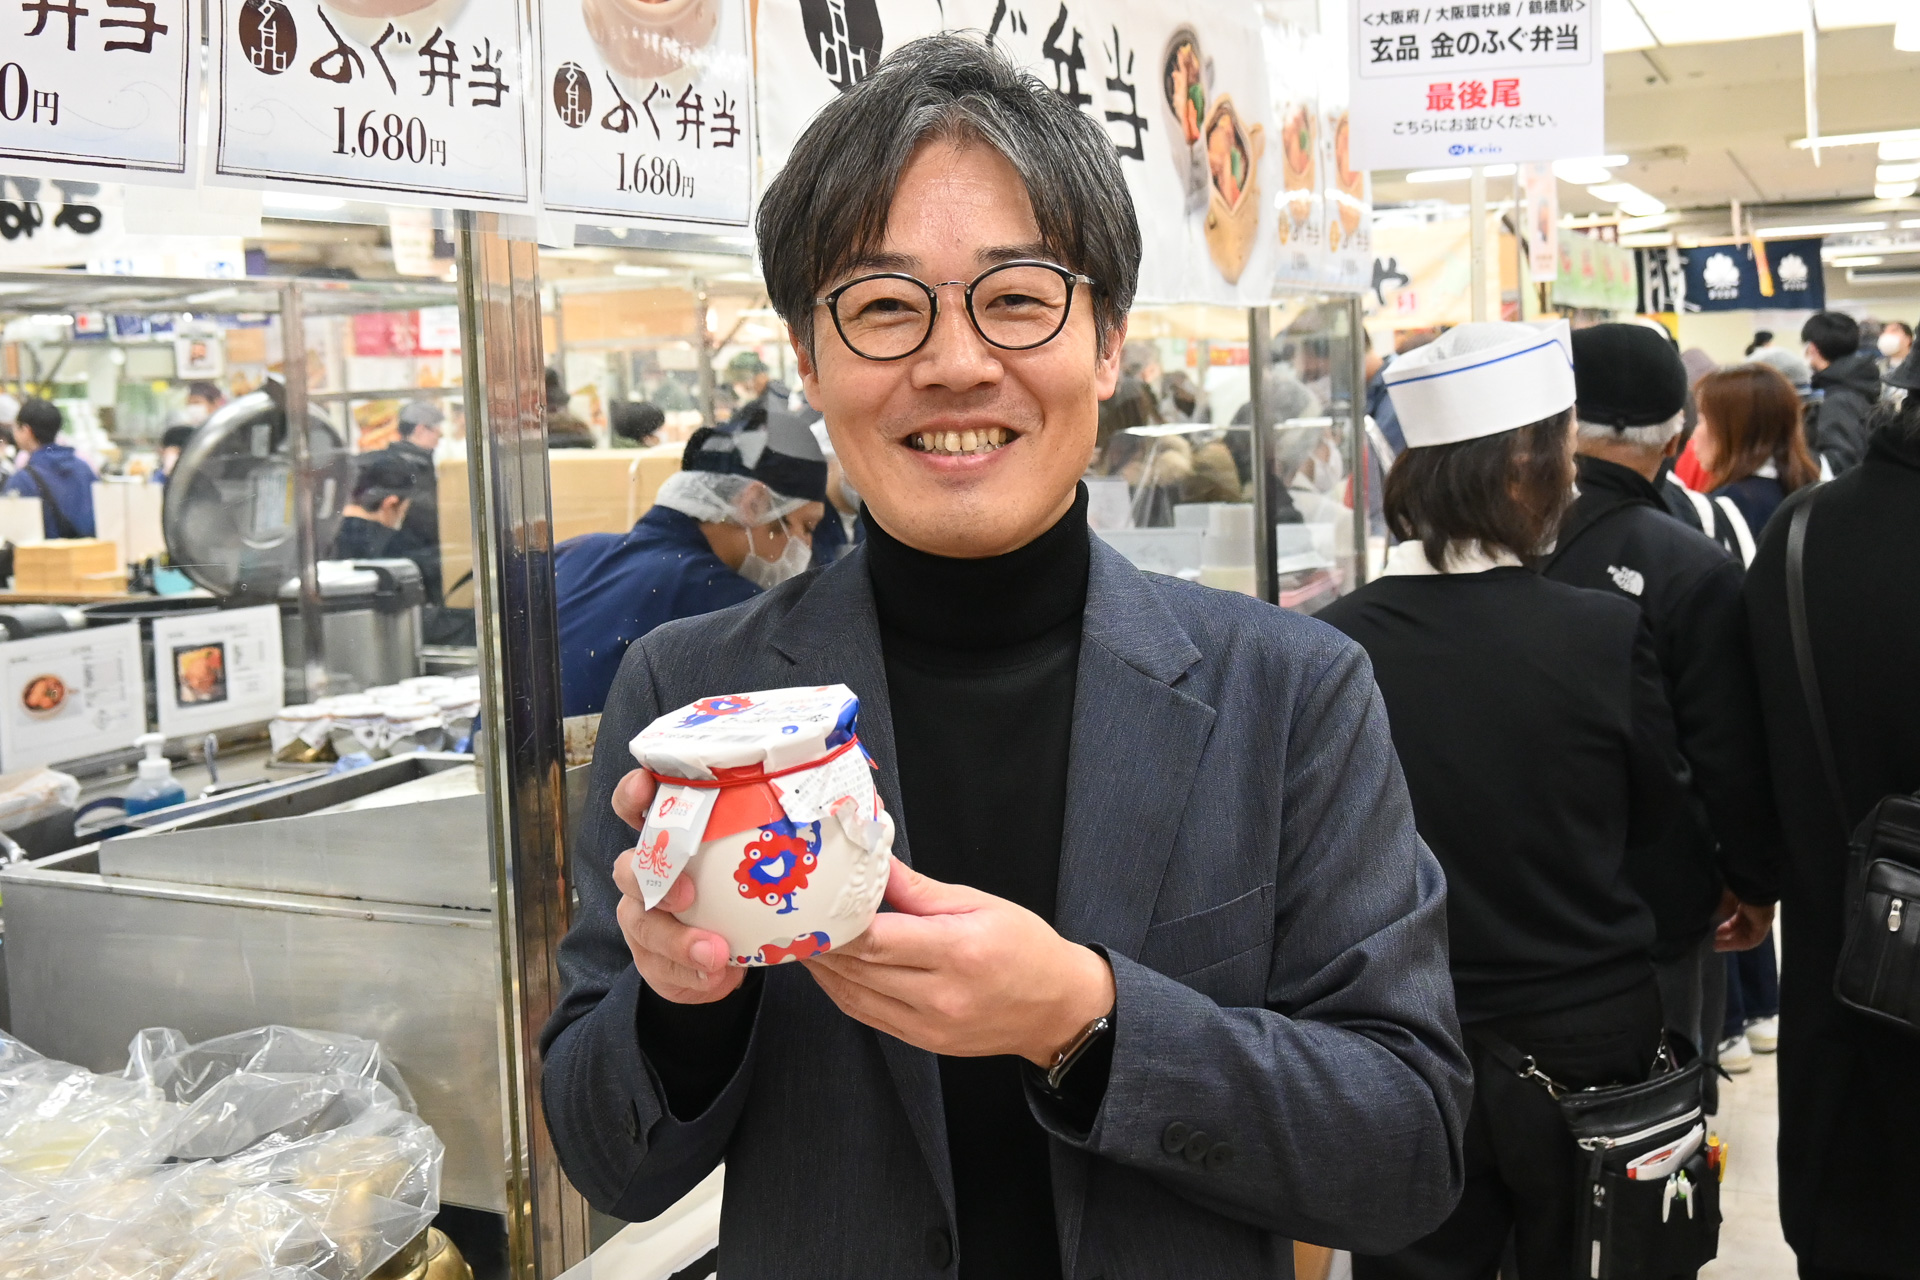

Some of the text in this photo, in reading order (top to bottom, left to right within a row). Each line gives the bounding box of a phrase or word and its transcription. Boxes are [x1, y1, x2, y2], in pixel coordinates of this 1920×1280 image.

[1370, 24, 1578, 63] 玄品 金のふぐ弁当
[600, 70, 741, 149] ふぐ弁当
[1425, 78, 1522, 112] 最後尾
[332, 106, 446, 166] 1,680円
[1392, 114, 1558, 135] こちらにお並びください。
[1467, 143, 1503, 155] Keio
[616, 152, 695, 199] 1,680円
